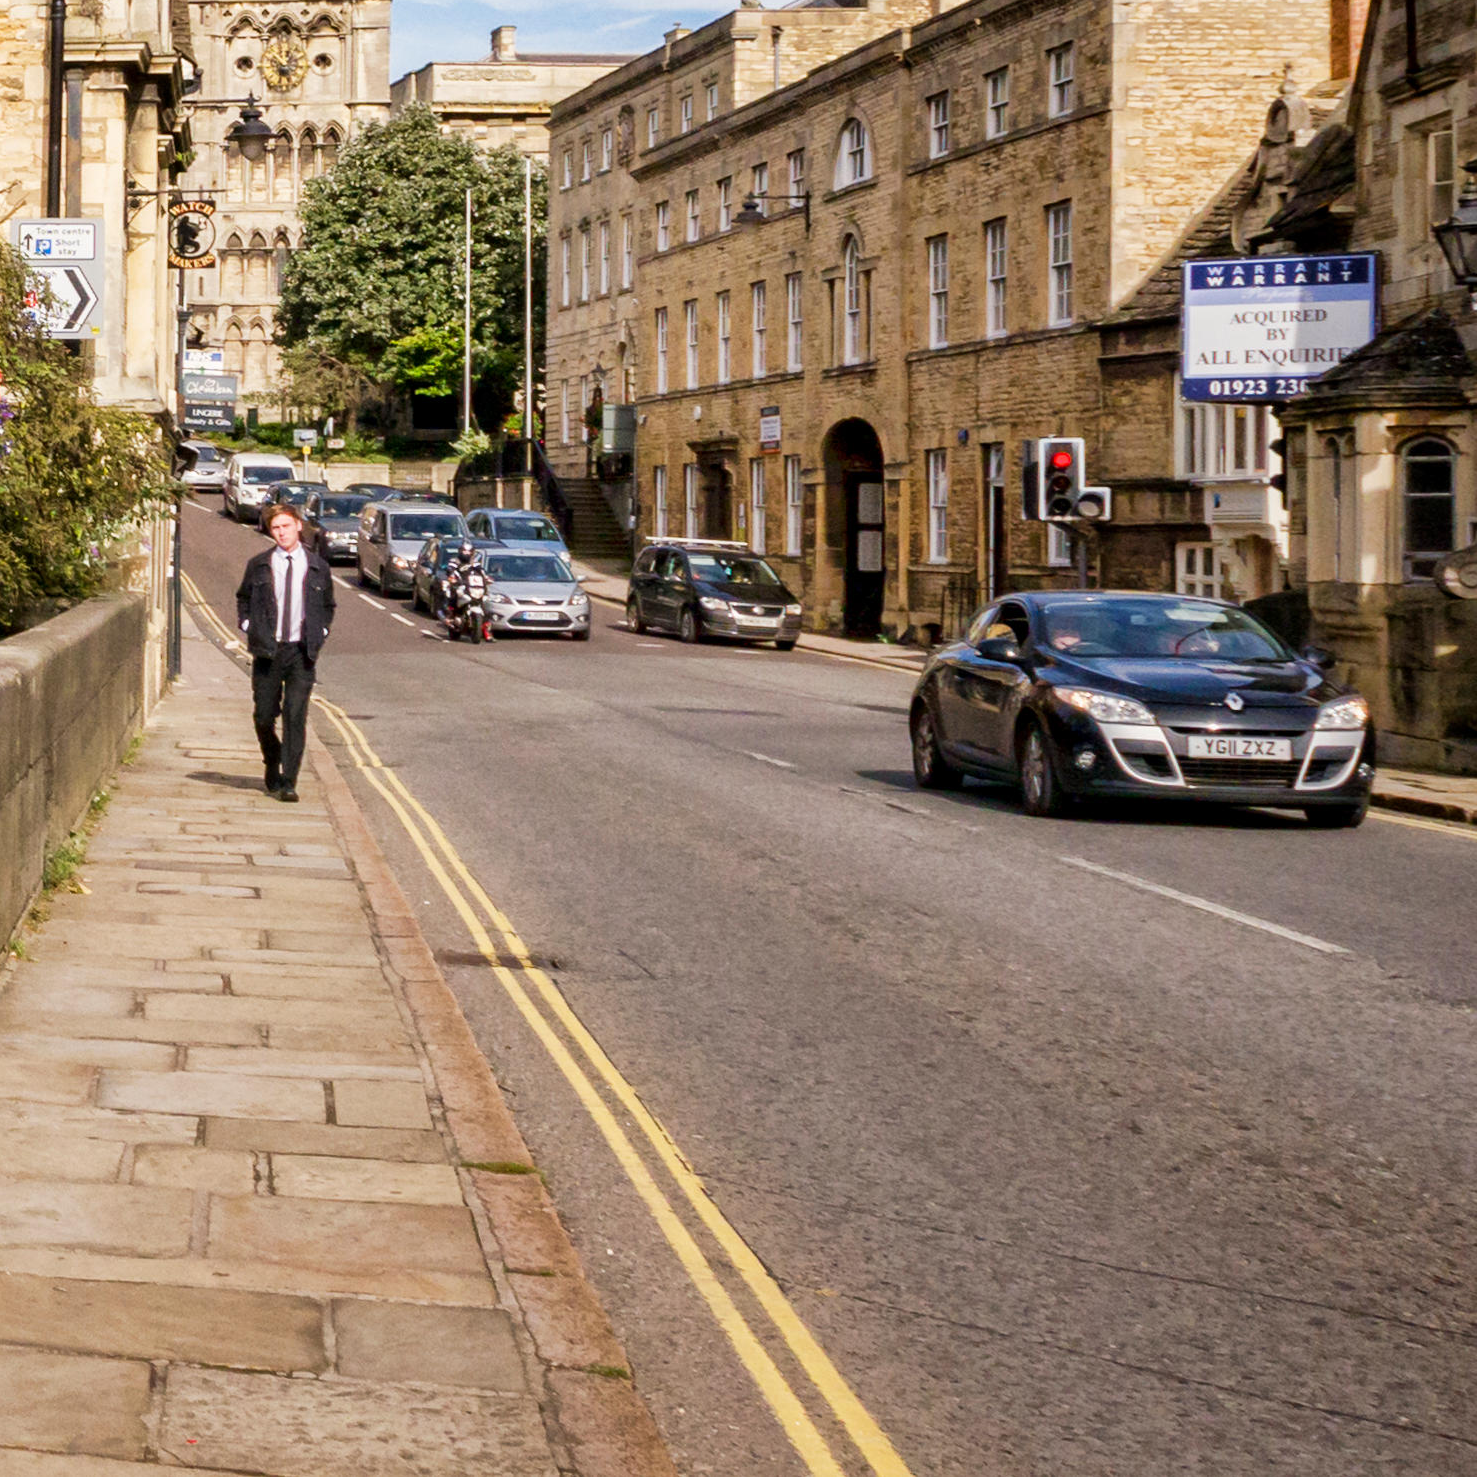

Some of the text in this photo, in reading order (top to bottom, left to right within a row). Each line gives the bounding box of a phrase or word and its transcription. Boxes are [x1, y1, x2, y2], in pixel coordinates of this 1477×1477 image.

[169, 201, 215, 216] WATCH
[35, 227, 91, 235] Town centre
[55, 238, 81, 246] Short
[58, 248, 77, 256] stay
[168, 253, 215, 268] MAKERS
[1207, 260, 1351, 276] WARRANT
[1206, 271, 1352, 287] WARRANT
[1230, 309, 1327, 325] ACQUIRED
[1266, 328, 1290, 341] BY
[1195, 347, 1357, 365] ALL ENQUIRIE
[1209, 379, 1268, 396] 01923
[192, 408, 223, 418] LINGERIE
[1204, 738, 1276, 756] YG11 ZXZ
